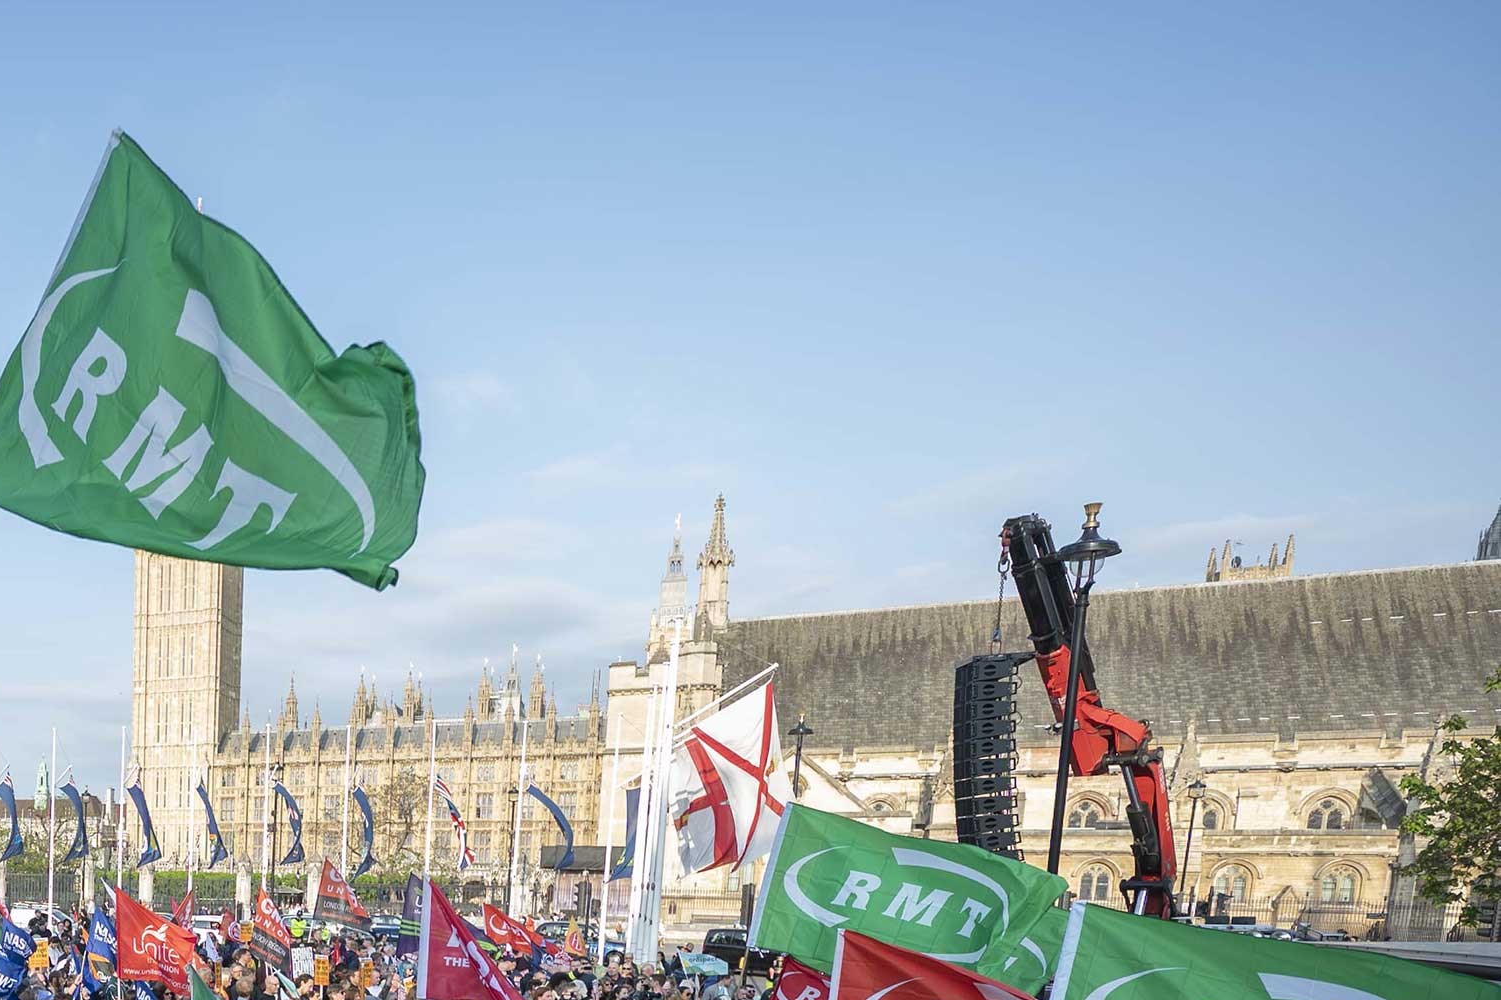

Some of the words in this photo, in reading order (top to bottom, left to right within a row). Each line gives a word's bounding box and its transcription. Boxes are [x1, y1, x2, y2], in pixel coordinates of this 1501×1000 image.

[50, 327, 297, 550] RMT
[832, 869, 992, 939] RMT
[133, 928, 179, 964] unite
[255, 915, 290, 944] UNION
[443, 956, 470, 968] THE
